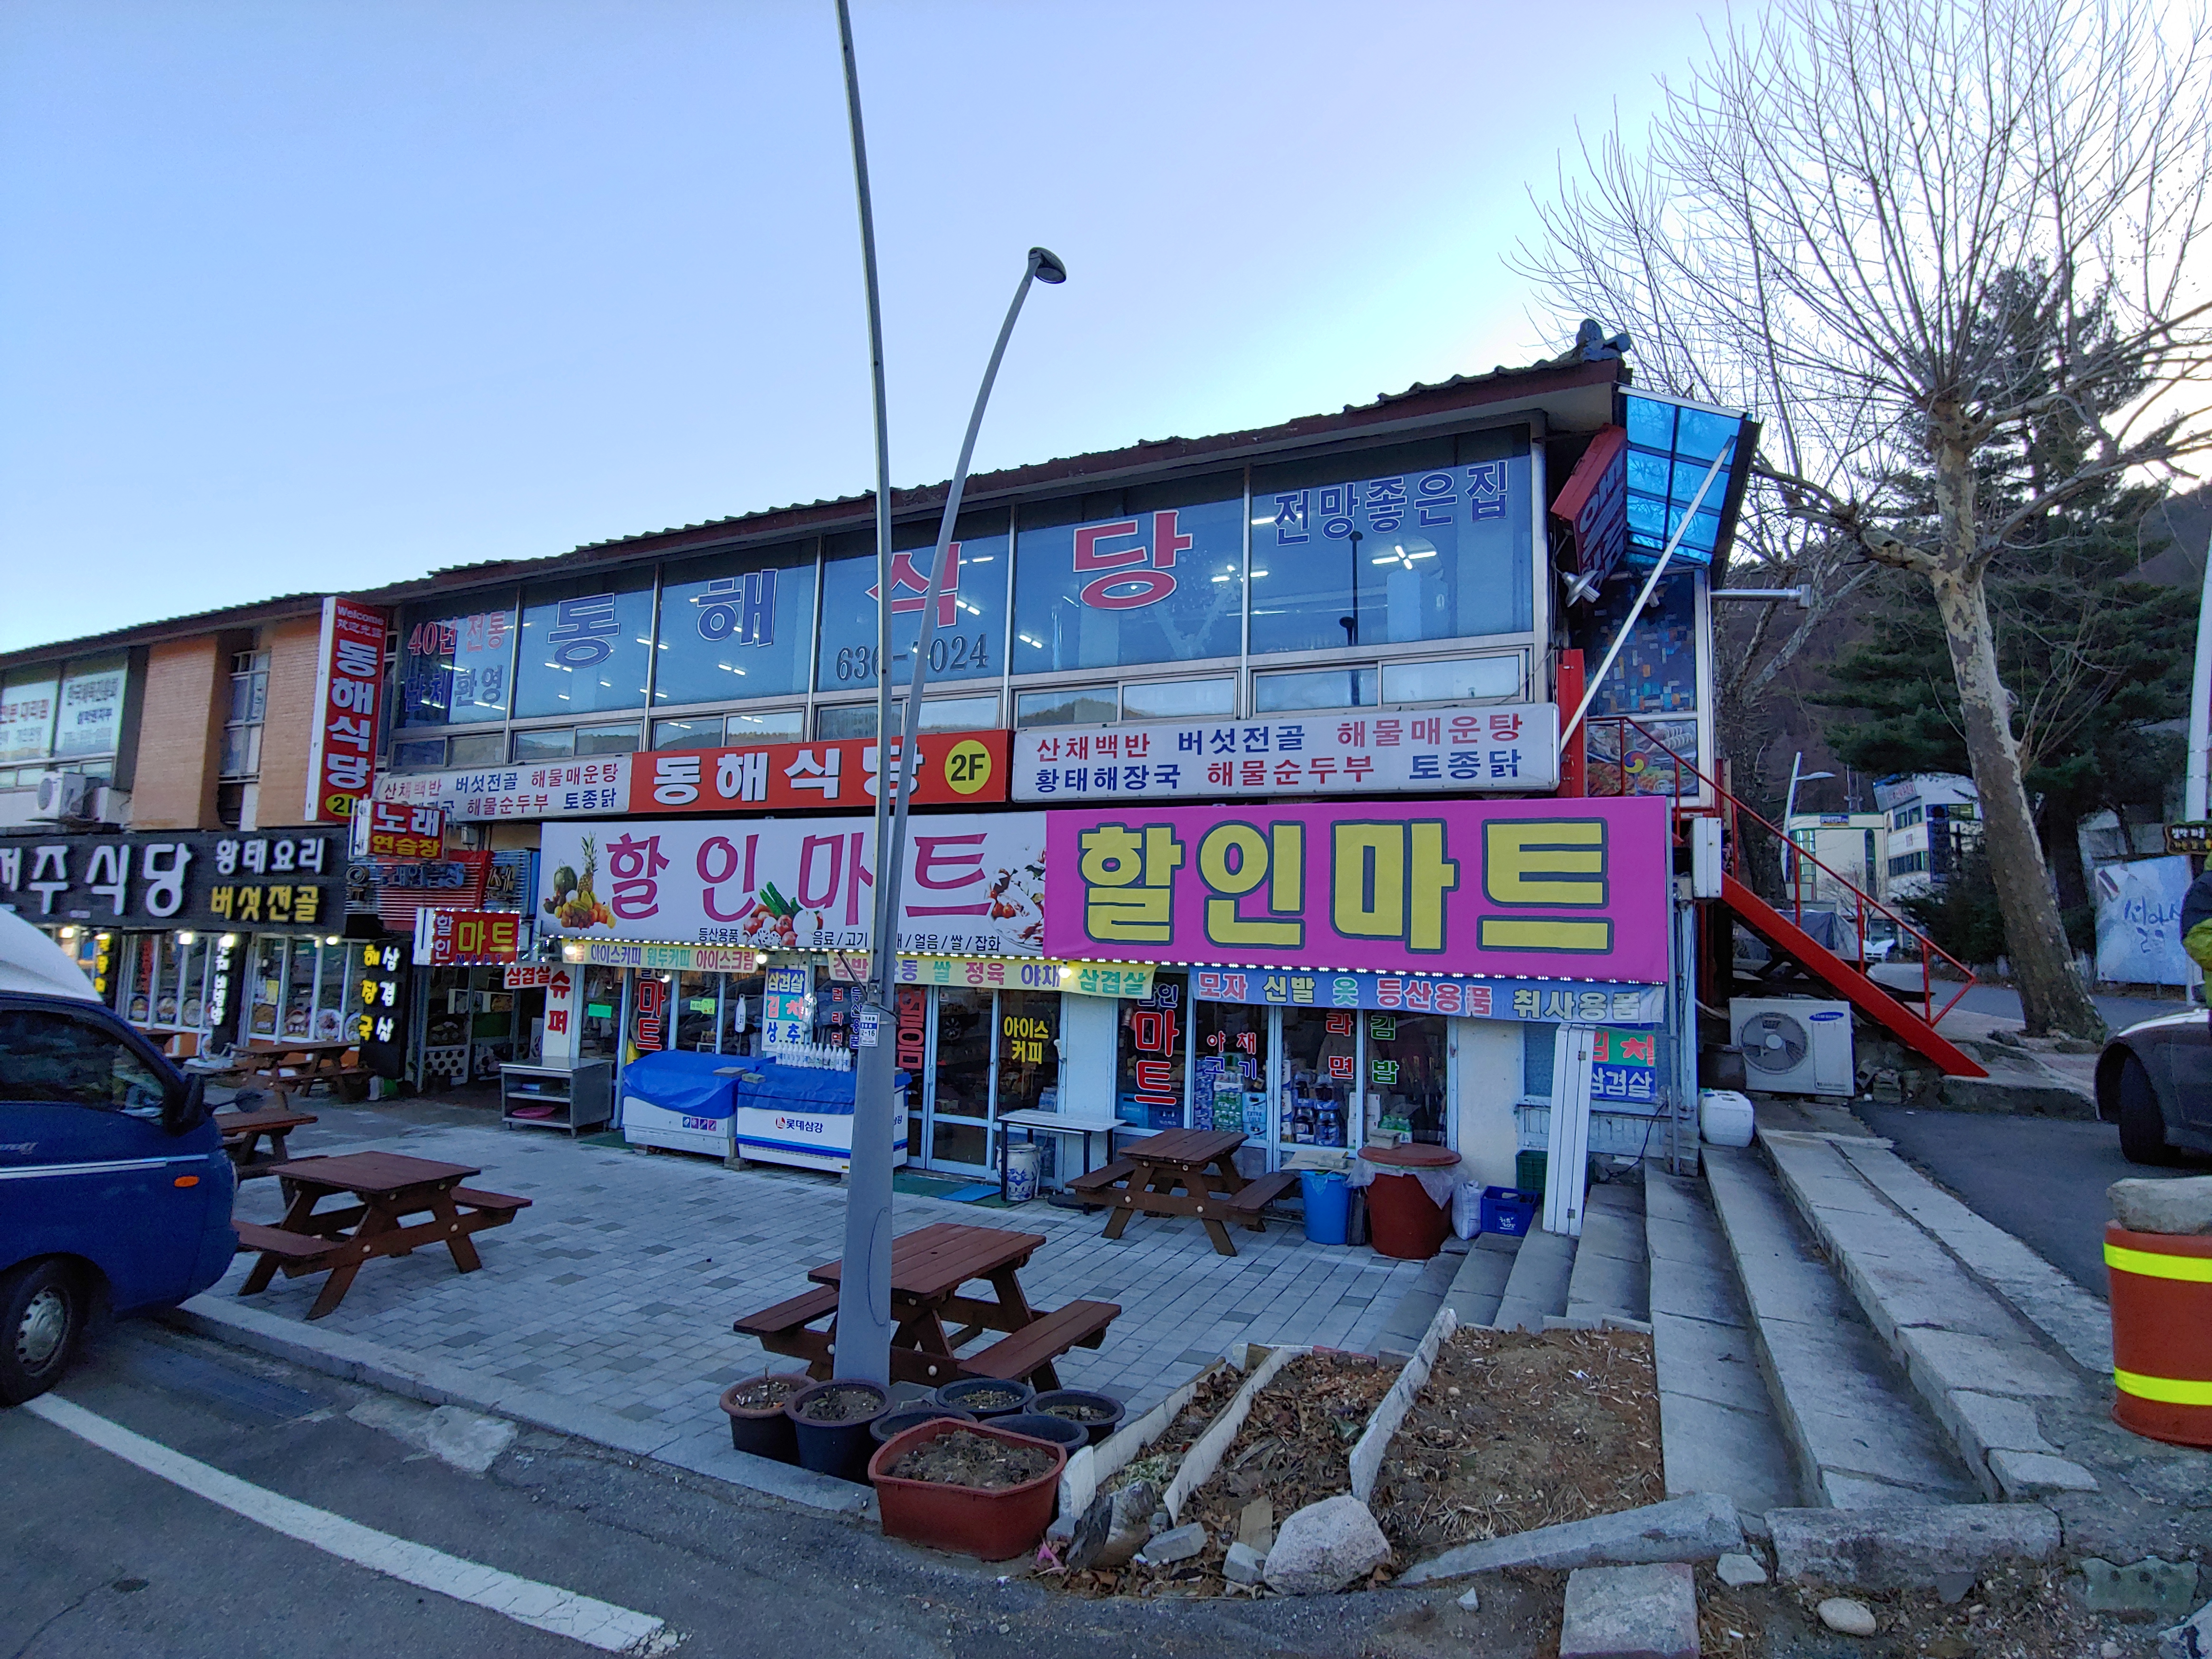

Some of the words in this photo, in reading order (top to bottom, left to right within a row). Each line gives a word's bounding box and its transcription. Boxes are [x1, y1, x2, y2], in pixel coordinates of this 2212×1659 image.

[1274, 460, 1509, 546] 전망좋은집
[337, 606, 384, 625] Welcome
[408, 619, 457, 656] 40년
[465, 610, 506, 652] 전통
[836, 633, 989, 680] 63-024
[405, 670, 449, 712] 단체
[454, 665, 503, 708] 환영
[326, 639, 378, 789] 동해식당
[1037, 733, 1151, 763] 산채백반
[1178, 725, 1306, 755] 버섯전골
[1337, 713, 1523, 748] 해물매운탕
[384, 779, 442, 800] 산채백반
[456, 772, 518, 794] 버섯전골
[532, 763, 619, 788] 해물매운탕
[951, 753, 985, 782] 2F
[1035, 764, 1182, 793] 황태해장국
[1207, 756, 1375, 787] 해물순두부
[1409, 749, 1522, 781] 토종닭
[373, 804, 440, 837] 노래
[467, 794, 549, 816] 해물순두부
[564, 788, 617, 810] 토종닭
[215, 837, 325, 876] 황태요리
[372, 835, 440, 858] 연습장
[606, 831, 993, 926] 할인마트
[1078, 818, 1614, 955] 할인마트
[210, 885, 320, 924] 버섯전골
[435, 915, 454, 960] 할인
[458, 920, 514, 956] 마트
[698, 927, 739, 943] 등산용품
[812, 931, 834, 946] 음료
[845, 932, 868, 947] 고기
[915, 934, 939, 949] 얼음
[951, 934, 963, 950] 쌀
[975, 936, 1001, 952] 잡화
[506, 966, 551, 986] 삼겹살
[591, 944, 641, 965] 아이스커피
[647, 948, 690, 969] 원두커피
[696, 950, 755, 972] 아이스크림
[833, 957, 868, 979] 김밥
[934, 961, 952, 983] 쌀
[965, 962, 1005, 986] 정육
[1021, 964, 1061, 989] 야채
[358, 944, 380, 1041] 해장국
[375, 945, 400, 1043] 삼겹살
[768, 972, 804, 993] 삼겹살
[1077, 967, 1146, 996] 삼겹살
[1198, 972, 1248, 1001] 모자
[1263, 975, 1315, 1004] 신발
[1333, 977, 1359, 1006] 옷
[1376, 978, 1493, 1017] 등산용품
[1513, 989, 1642, 1021] 취사용품
[547, 970, 571, 1035] 슈퍼
[636, 980, 666, 1051] 마트
[767, 995, 804, 1020] 김치
[766, 1021, 801, 1044] 상추
[1004, 1015, 1049, 1039] 아이스
[1207, 1030, 1257, 1055] 야채
[1011, 1040, 1043, 1065] 커피
[1134, 1009, 1180, 1106] 마트
[1325, 1012, 1354, 1080] 라면
[1371, 1015, 1400, 1085] 김밥
[1204, 1056, 1257, 1080] 고기
[786, 1118, 824, 1134] 롯데삼강
